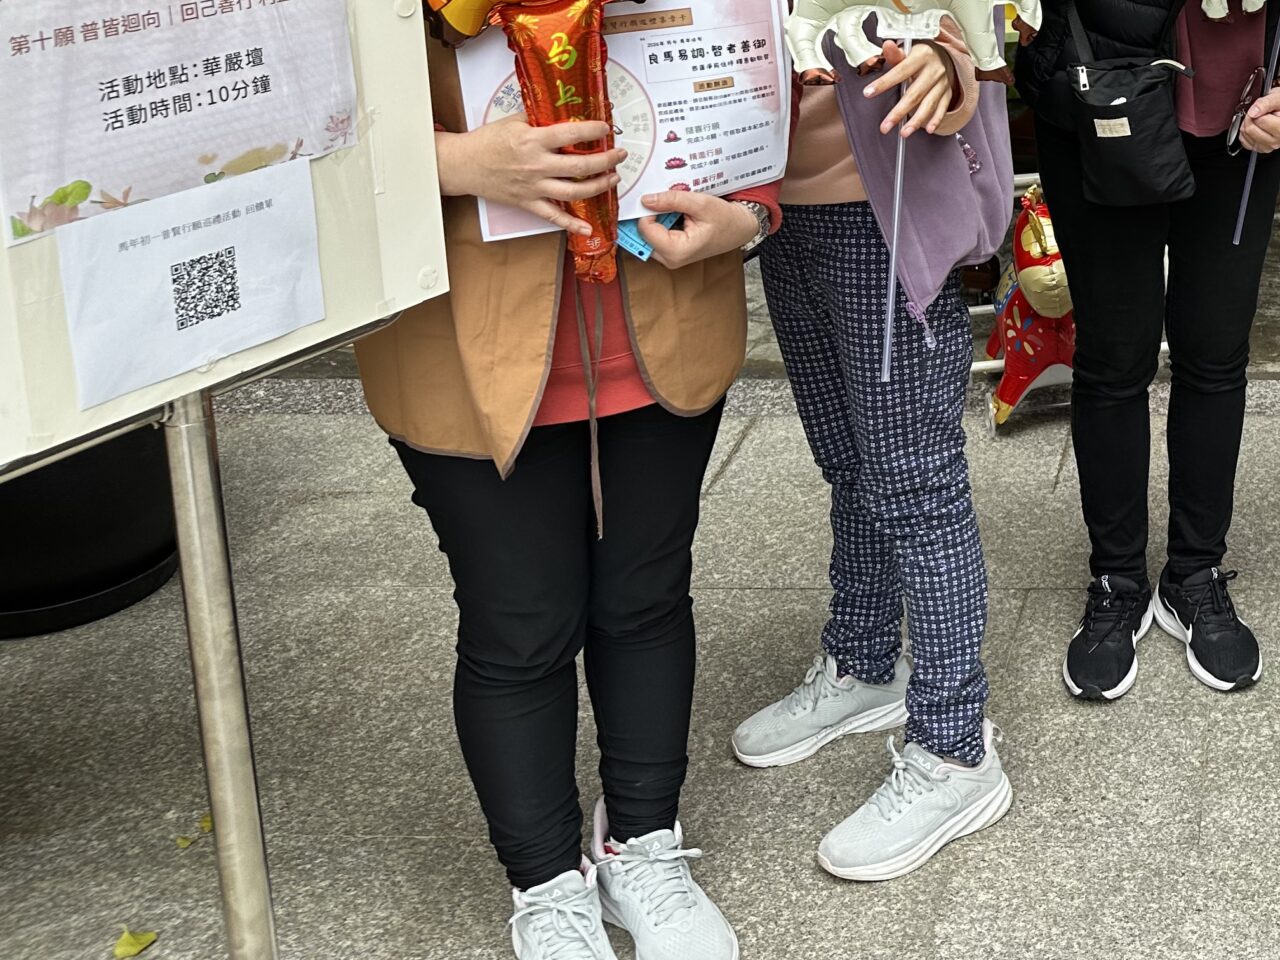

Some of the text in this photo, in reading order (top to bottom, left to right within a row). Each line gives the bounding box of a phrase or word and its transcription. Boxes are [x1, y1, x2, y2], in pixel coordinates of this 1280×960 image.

[10, 25, 76, 57] 第十願
[80, 10, 161, 42] 普皆迴向
